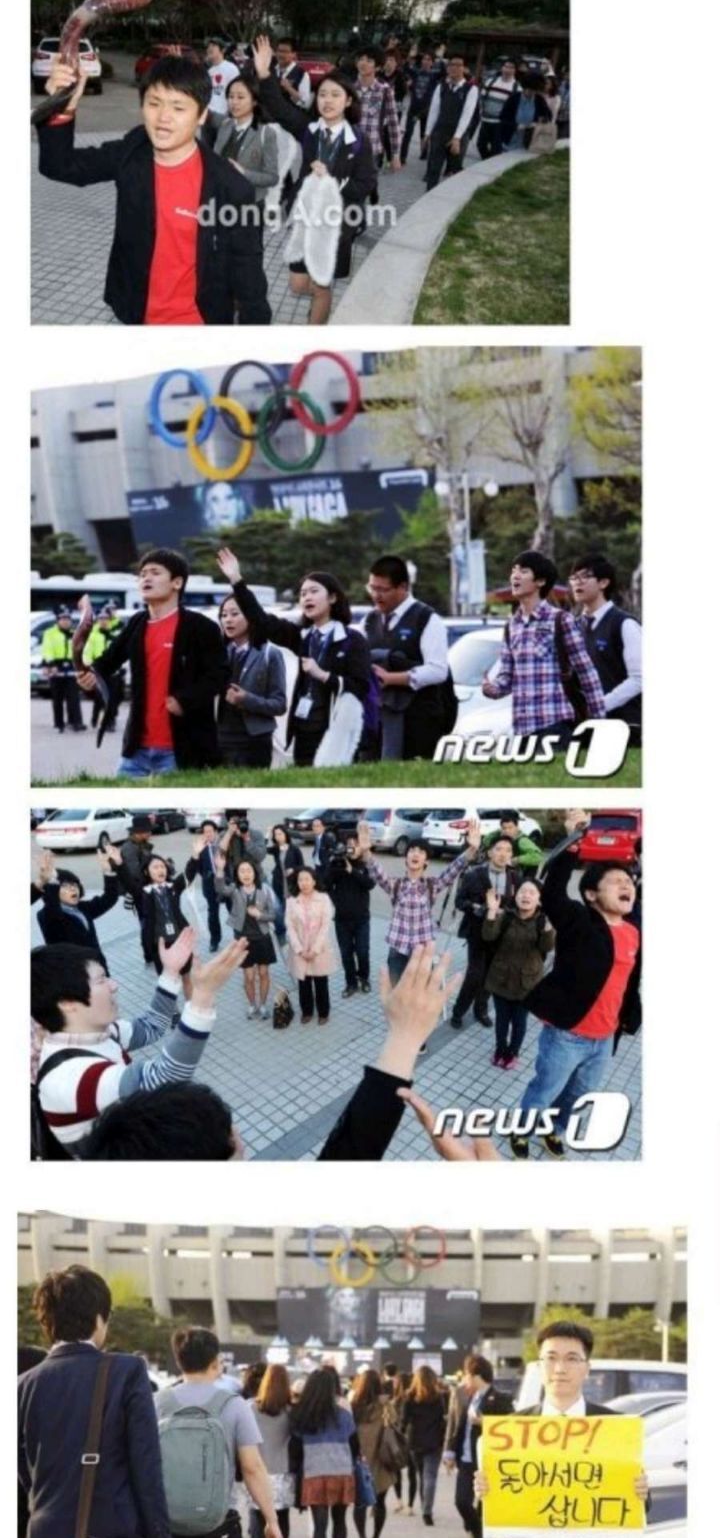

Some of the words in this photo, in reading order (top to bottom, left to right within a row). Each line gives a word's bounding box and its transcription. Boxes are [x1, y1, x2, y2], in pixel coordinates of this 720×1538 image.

[488, 1418, 603, 1454] STOP!
[498, 1459, 603, 1494] 돌아서면
[538, 1495, 631, 1528] 삽니다
